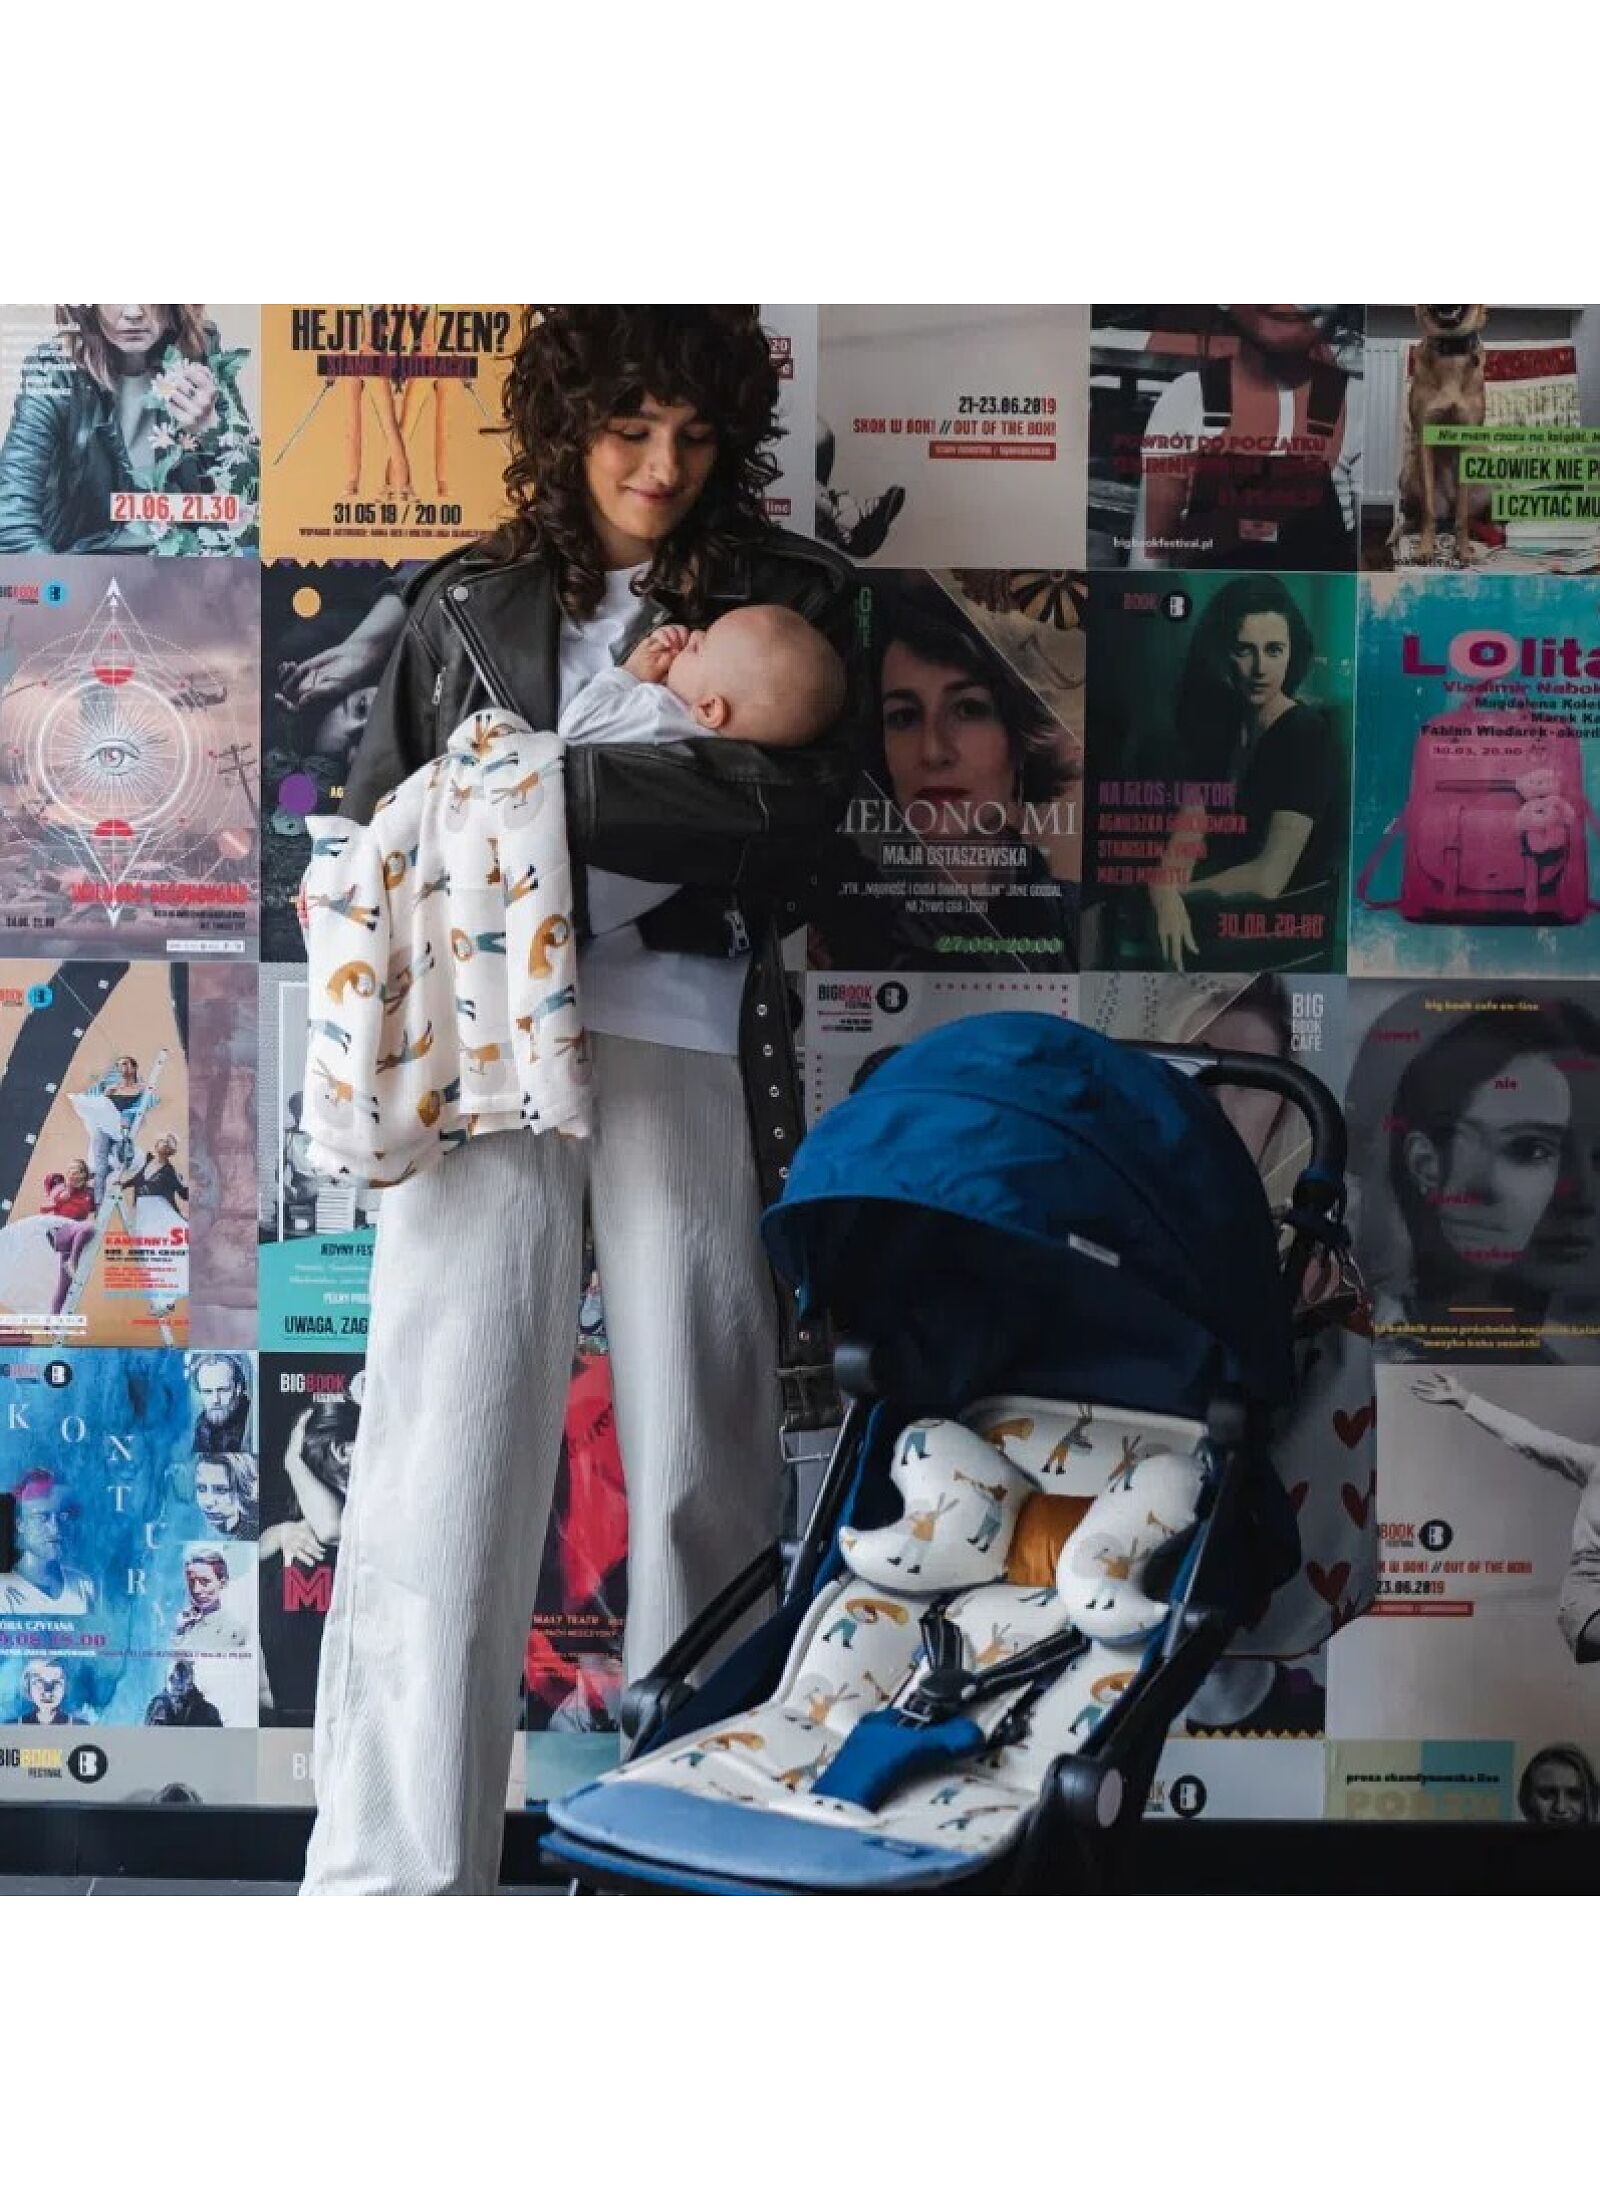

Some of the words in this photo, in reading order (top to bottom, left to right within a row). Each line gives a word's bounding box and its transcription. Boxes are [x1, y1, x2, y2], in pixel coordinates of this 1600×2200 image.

[292, 309, 362, 350] HEJT
[371, 310, 430, 352] CZY
[438, 311, 511, 352] ZEN?
[982, 420, 997, 434] OF
[1465, 457, 1551, 479] CZŁOWIEK
[1556, 459, 1583, 479] NIE
[114, 495, 175, 524] 21.06,
[182, 495, 237, 520] 21.30
[1509, 491, 1573, 518] CZYTAĆ
[836, 799, 1007, 835] IELONO
[1293, 992, 1324, 1017] BIG
[170, 1228, 190, 1246] S
[284, 1315, 338, 1335] UWAGA,
